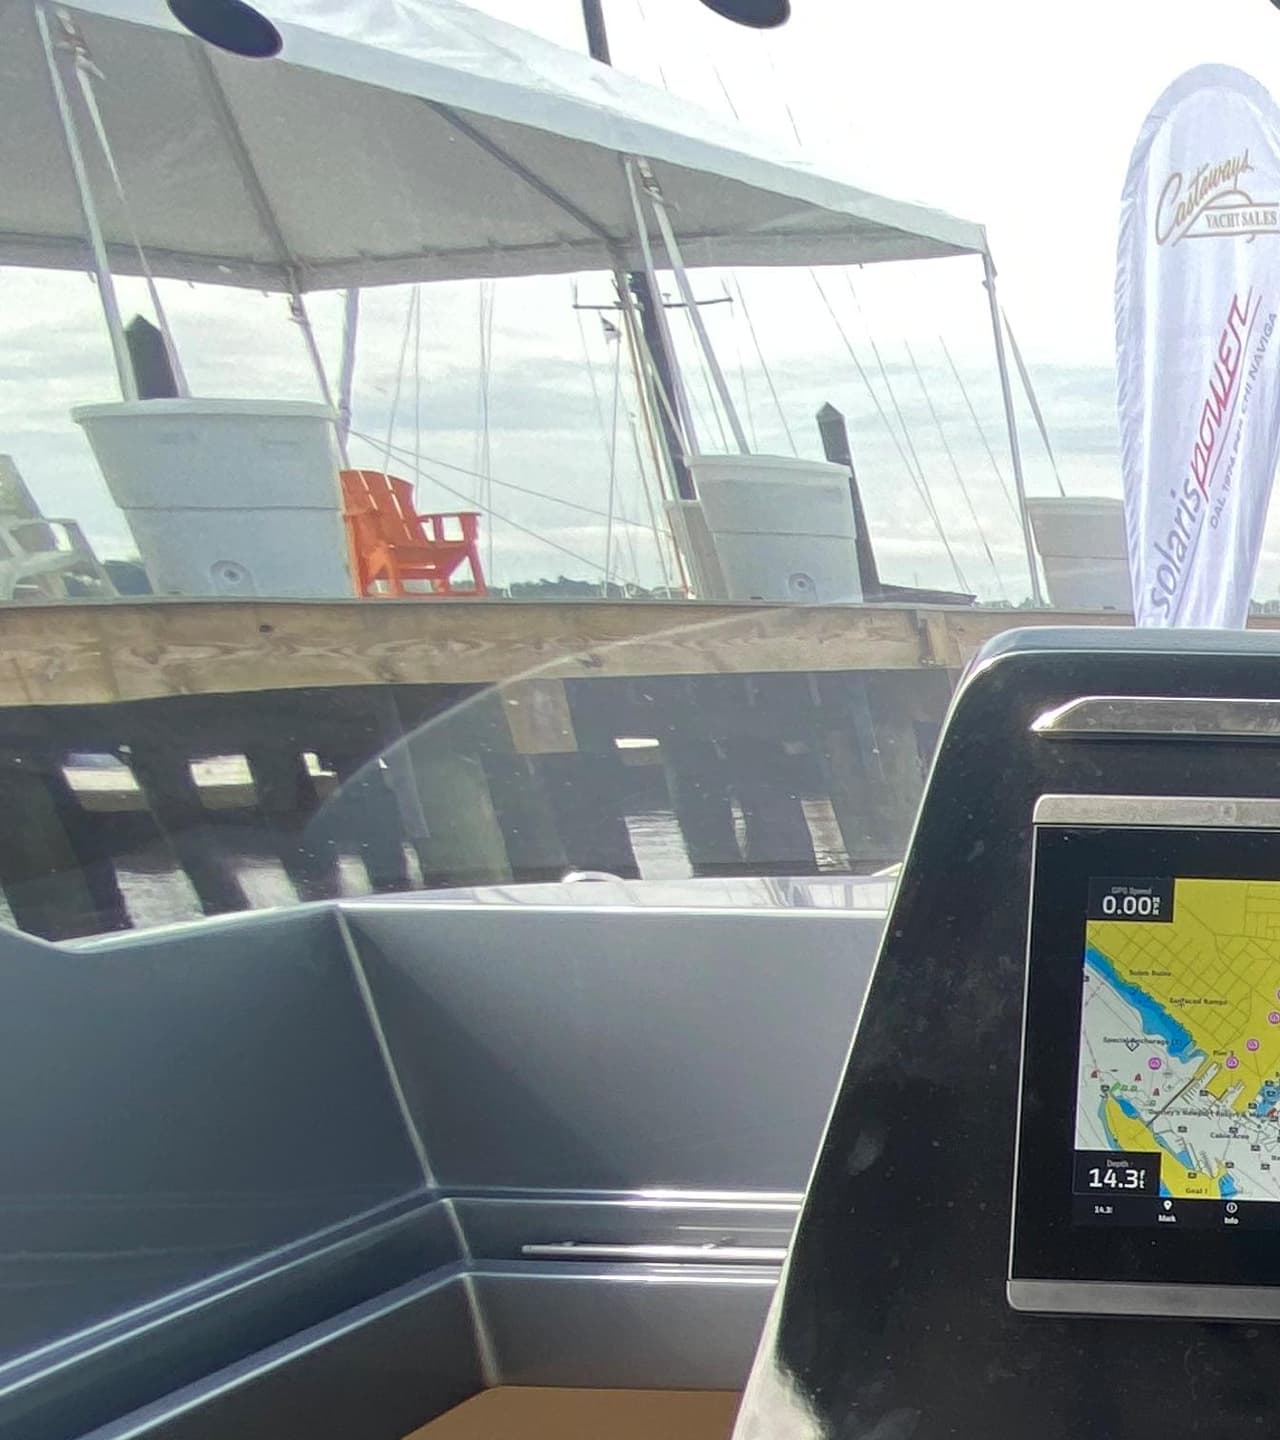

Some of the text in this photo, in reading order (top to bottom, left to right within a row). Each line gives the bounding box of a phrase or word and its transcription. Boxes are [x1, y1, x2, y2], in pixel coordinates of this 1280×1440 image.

[1155, 147, 1254, 246] Castaways
[1205, 210, 1278, 229] YACHT SALES
[1248, 312, 1278, 382] NAVIGA
[1103, 895, 1152, 916] 0.00
